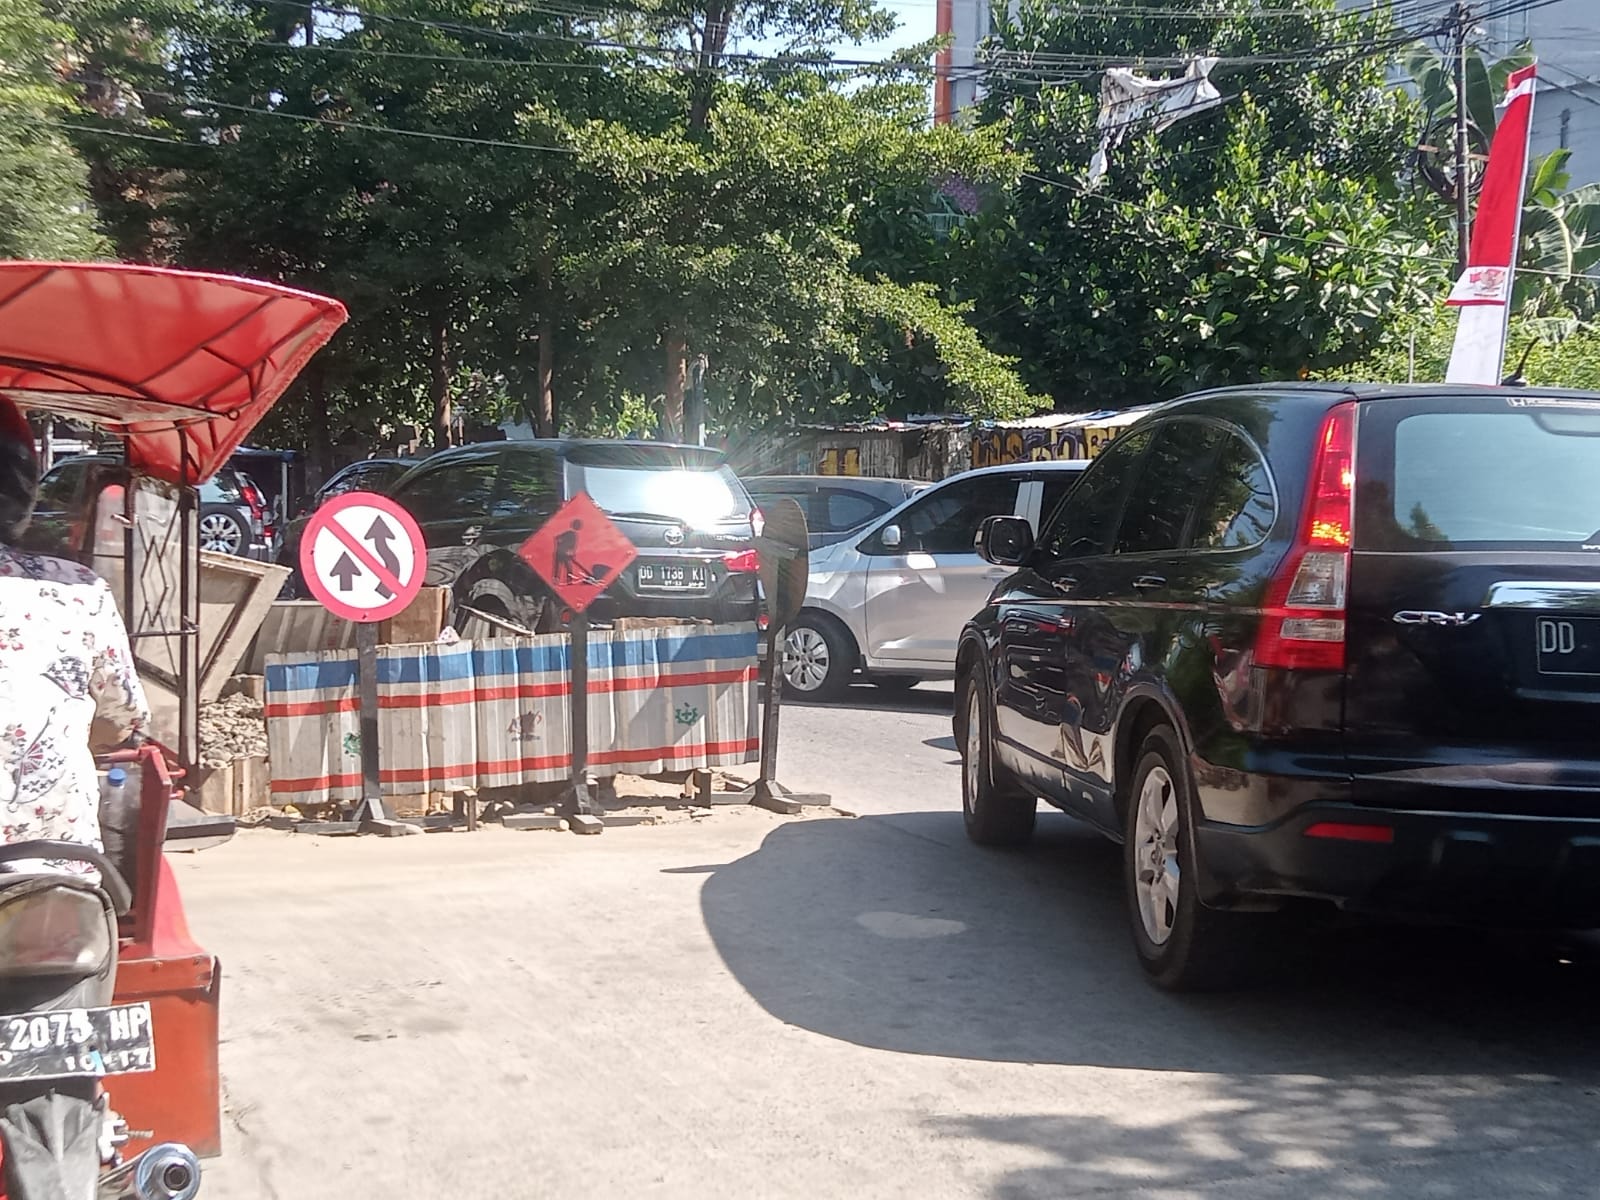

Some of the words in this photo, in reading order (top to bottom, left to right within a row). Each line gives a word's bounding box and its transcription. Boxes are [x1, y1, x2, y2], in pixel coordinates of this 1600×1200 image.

[640, 566, 653, 579] DD
[1540, 621, 1575, 653] DD
[109, 1007, 147, 1040] HP
